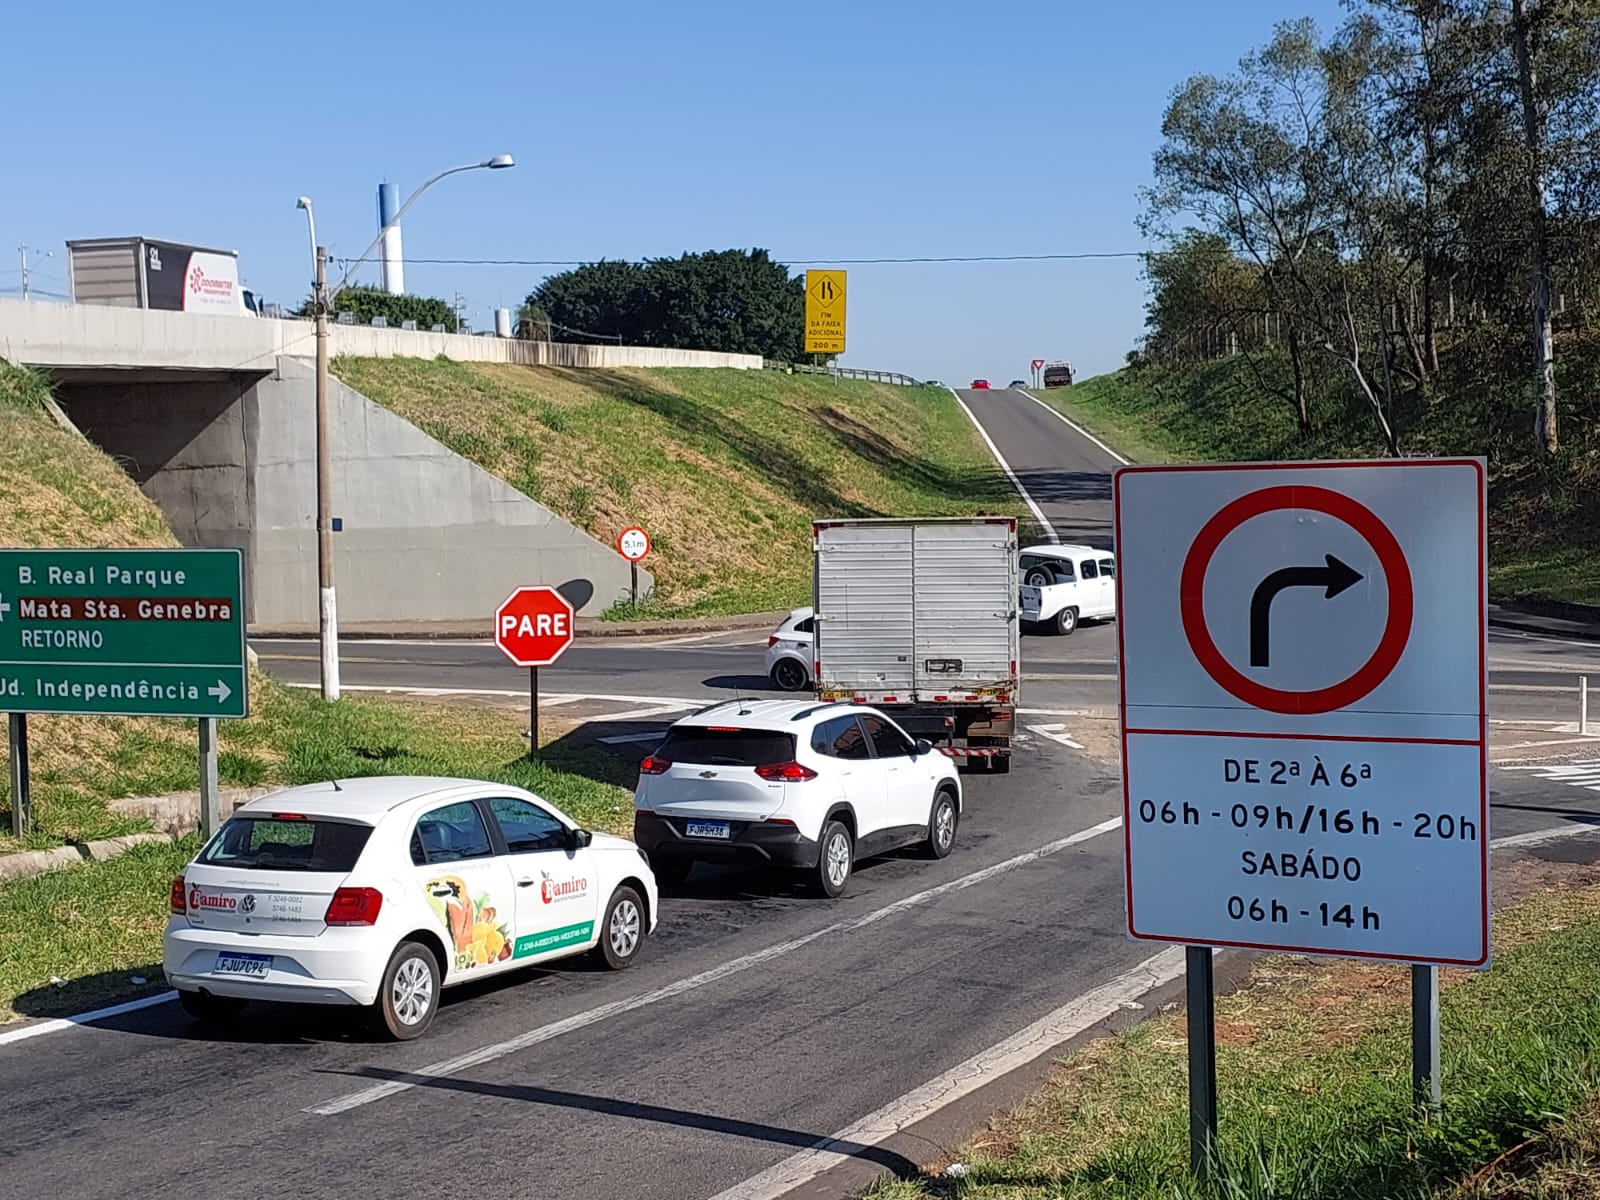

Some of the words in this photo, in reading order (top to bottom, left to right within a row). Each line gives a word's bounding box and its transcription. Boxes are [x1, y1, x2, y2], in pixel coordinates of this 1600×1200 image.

[18, 565, 37, 585] B.
[48, 566, 95, 585] Real
[106, 565, 187, 589] Parque
[20, 600, 72, 619] Mata
[84, 599, 127, 619] Sta.
[138, 600, 232, 620] Genebra
[501, 613, 568, 638] PARE
[21, 629, 104, 649] RETORNO
[36, 678, 200, 701] Independência
[1224, 758, 1261, 784] DE
[1270, 759, 1301, 786] 2ª
[1310, 755, 1331, 787] À
[1339, 761, 1373, 788] 6ª
[1139, 799, 1200, 826] 06h
[1230, 803, 1380, 836] 09h/16h
[1413, 812, 1477, 841] 20h
[1240, 848, 1362, 883] SABÁDO
[1227, 895, 1289, 924] 06h
[1319, 902, 1381, 931] 14h
